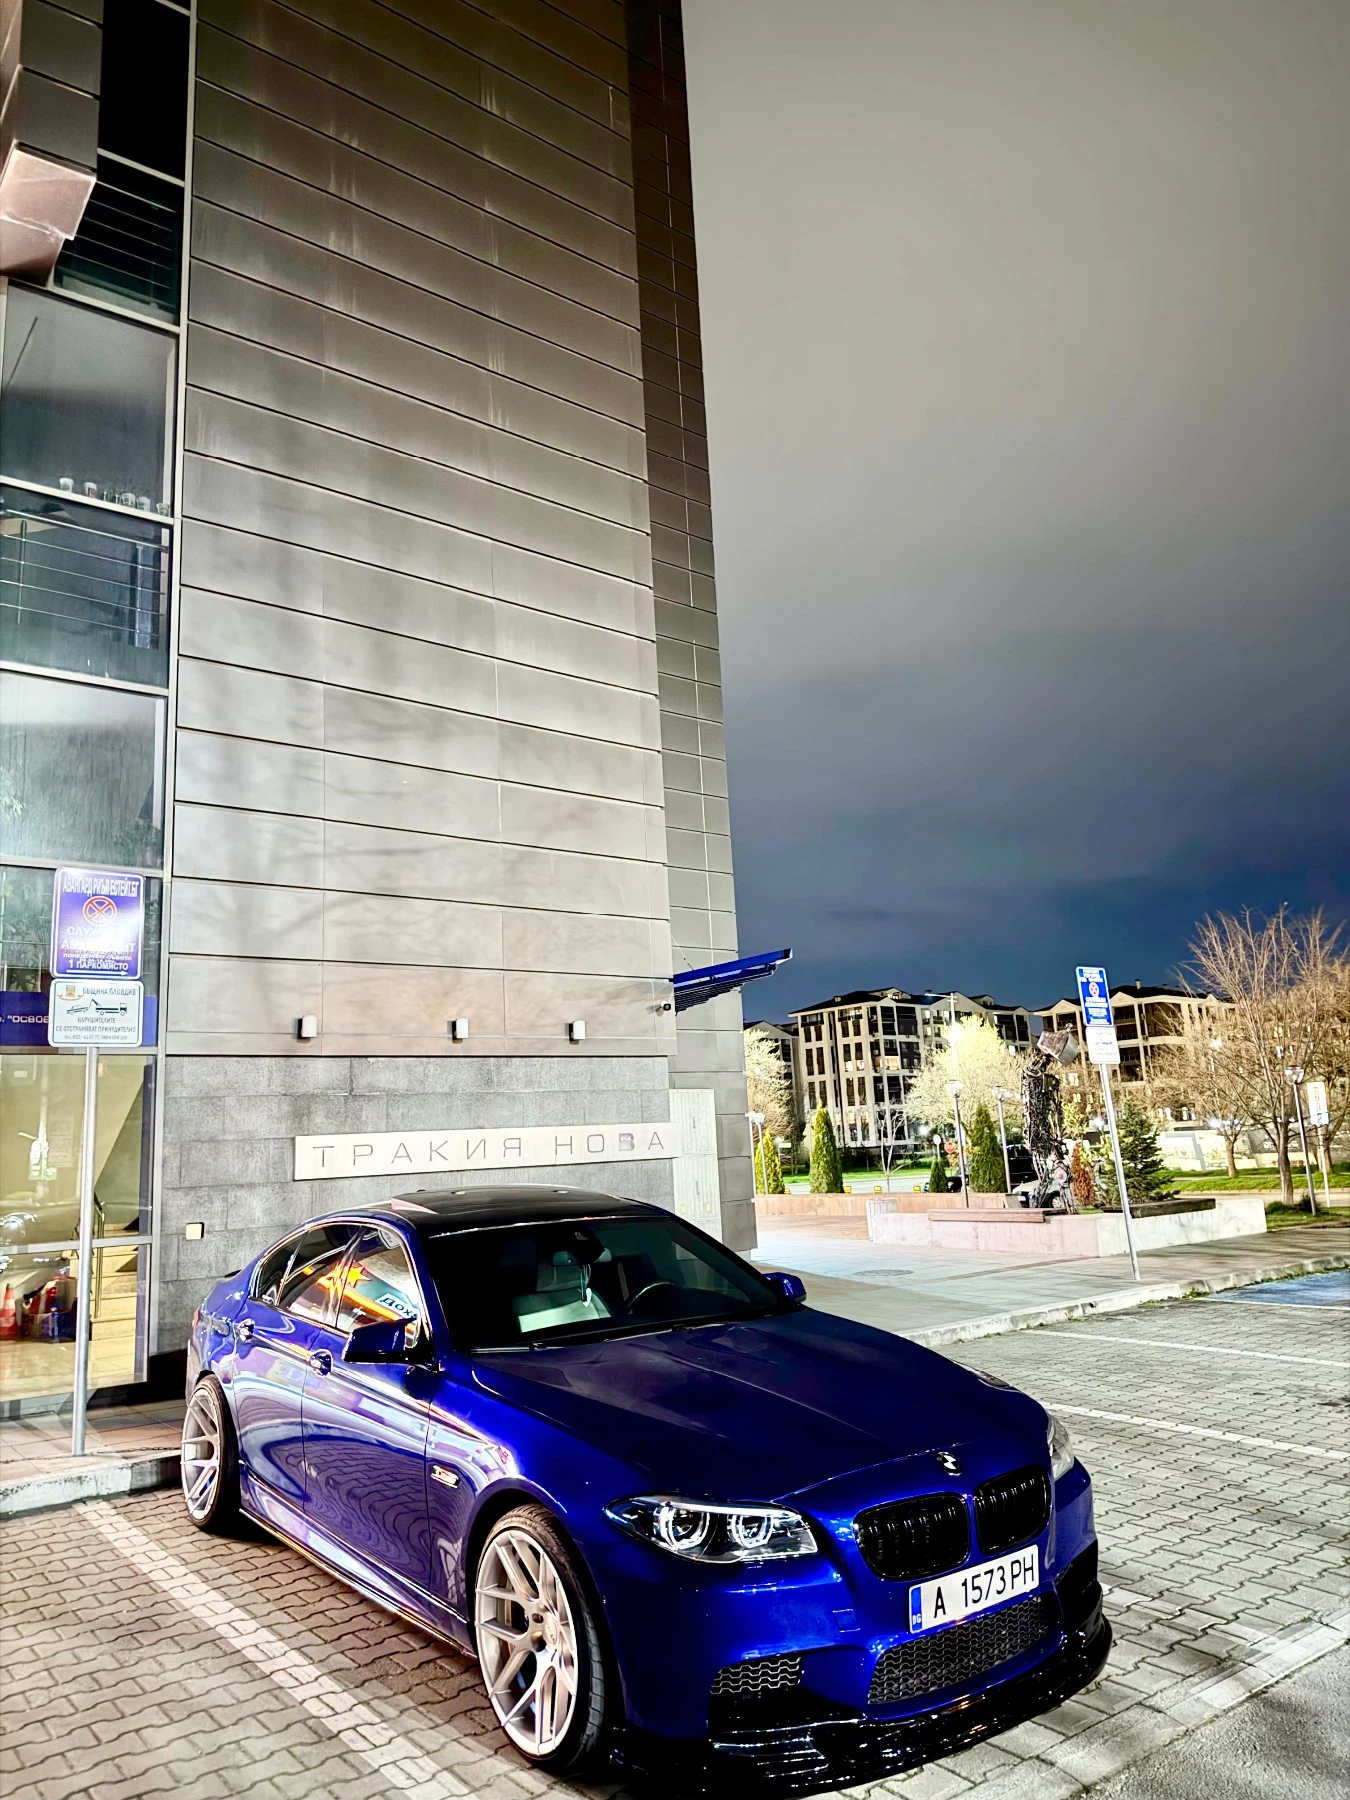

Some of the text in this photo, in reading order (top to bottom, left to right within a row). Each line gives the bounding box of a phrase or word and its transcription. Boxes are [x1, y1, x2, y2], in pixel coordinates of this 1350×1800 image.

[62, 875, 93, 897] АВАНГАРД
[68, 959, 74, 969] 1
[76, 960, 129, 971] ПАРКОМЯСТО
[82, 987, 137, 996] ОБЩИНА ПЛОВДИВ
[312, 1131, 665, 1168] ТРАКИЯ НОВА
[933, 1554, 1034, 1619] A 1573 PH
[912, 1614, 922, 1625] BG
